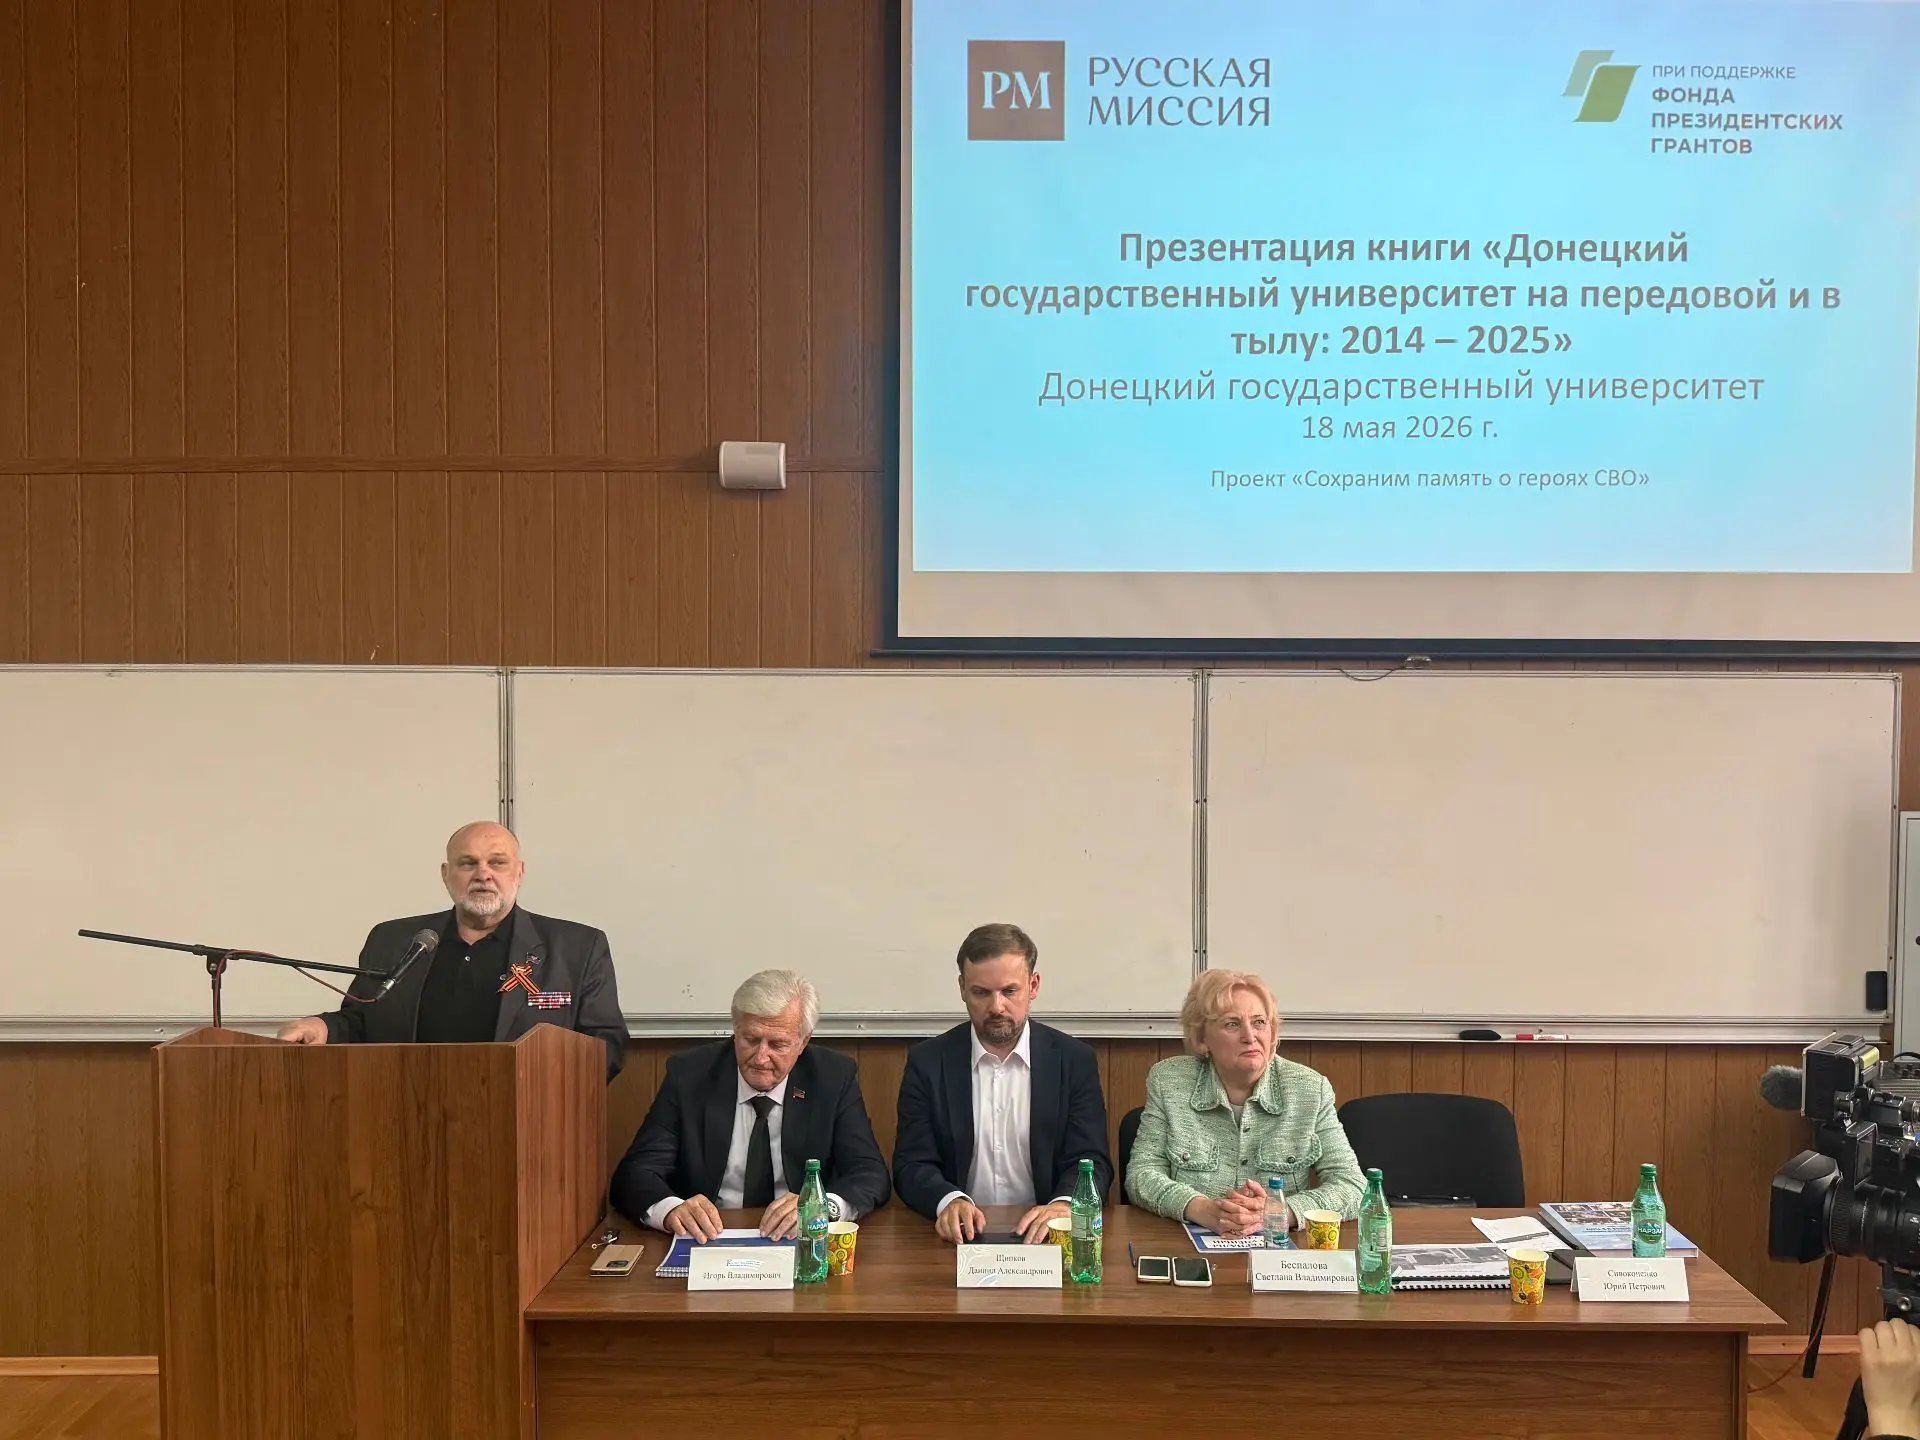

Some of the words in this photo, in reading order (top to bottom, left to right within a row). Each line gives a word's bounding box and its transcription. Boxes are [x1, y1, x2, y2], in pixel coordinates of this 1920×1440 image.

[1089, 56, 1271, 88] РУССКАЯ
[1652, 64, 1686, 79] ПРИ
[1690, 65, 1797, 81] ПОДДЕРЖКЕ
[982, 70, 1052, 110] РМ
[1651, 86, 1736, 107] ФОНДА
[1088, 95, 1270, 127] МИССИЯ
[1651, 112, 1843, 132] ПРЕЗИДЕНТСКИХ
[1651, 137, 1753, 155] ГРАНТОВ
[1120, 233, 1355, 269] Презентация
[1367, 239, 1470, 261] книги
[1482, 231, 1688, 268] «Донецкий
[966, 276, 1279, 315] государственный
[1289, 284, 1517, 315] университет
[1527, 285, 1568, 308] на
[1580, 277, 1776, 315] передовой
[1789, 287, 1810, 309] и
[1822, 287, 1841, 309] в
[1230, 332, 1330, 362] тылу:
[1341, 325, 1426, 355] 2014
[1466, 324, 1572, 355] 2025»
[1038, 371, 1215, 407] Донецкий
[1228, 371, 1533, 407] государственный
[1545, 377, 1765, 407] университет
[1302, 415, 1334, 439] 18
[1342, 421, 1396, 439] мая
[1405, 415, 1473, 439] 2026
[1482, 420, 1498, 438] г.
[1211, 469, 1287, 492] Проект
[1292, 469, 1410, 493] «Сохраним
[1417, 473, 1493, 487] память
[1498, 473, 1512, 487] о
[1518, 472, 1589, 492] героях
[1594, 468, 1650, 487] СВО»
[1637, 1227, 1664, 1235] НАРЗАН
[996, 1253, 1026, 1262] Щипков
[1280, 1260, 1328, 1270] Беспалова
[703, 1272, 726, 1281] Игорь
[727, 1271, 782, 1281] Владимирович
[997, 1267, 1054, 1276] Александрович
[1255, 1272, 1293, 1282] Светлана
[1295, 1273, 1355, 1284] Владимировна
[1603, 1282, 1627, 1291] Юрий
[1629, 1283, 1665, 1292] Петрович
